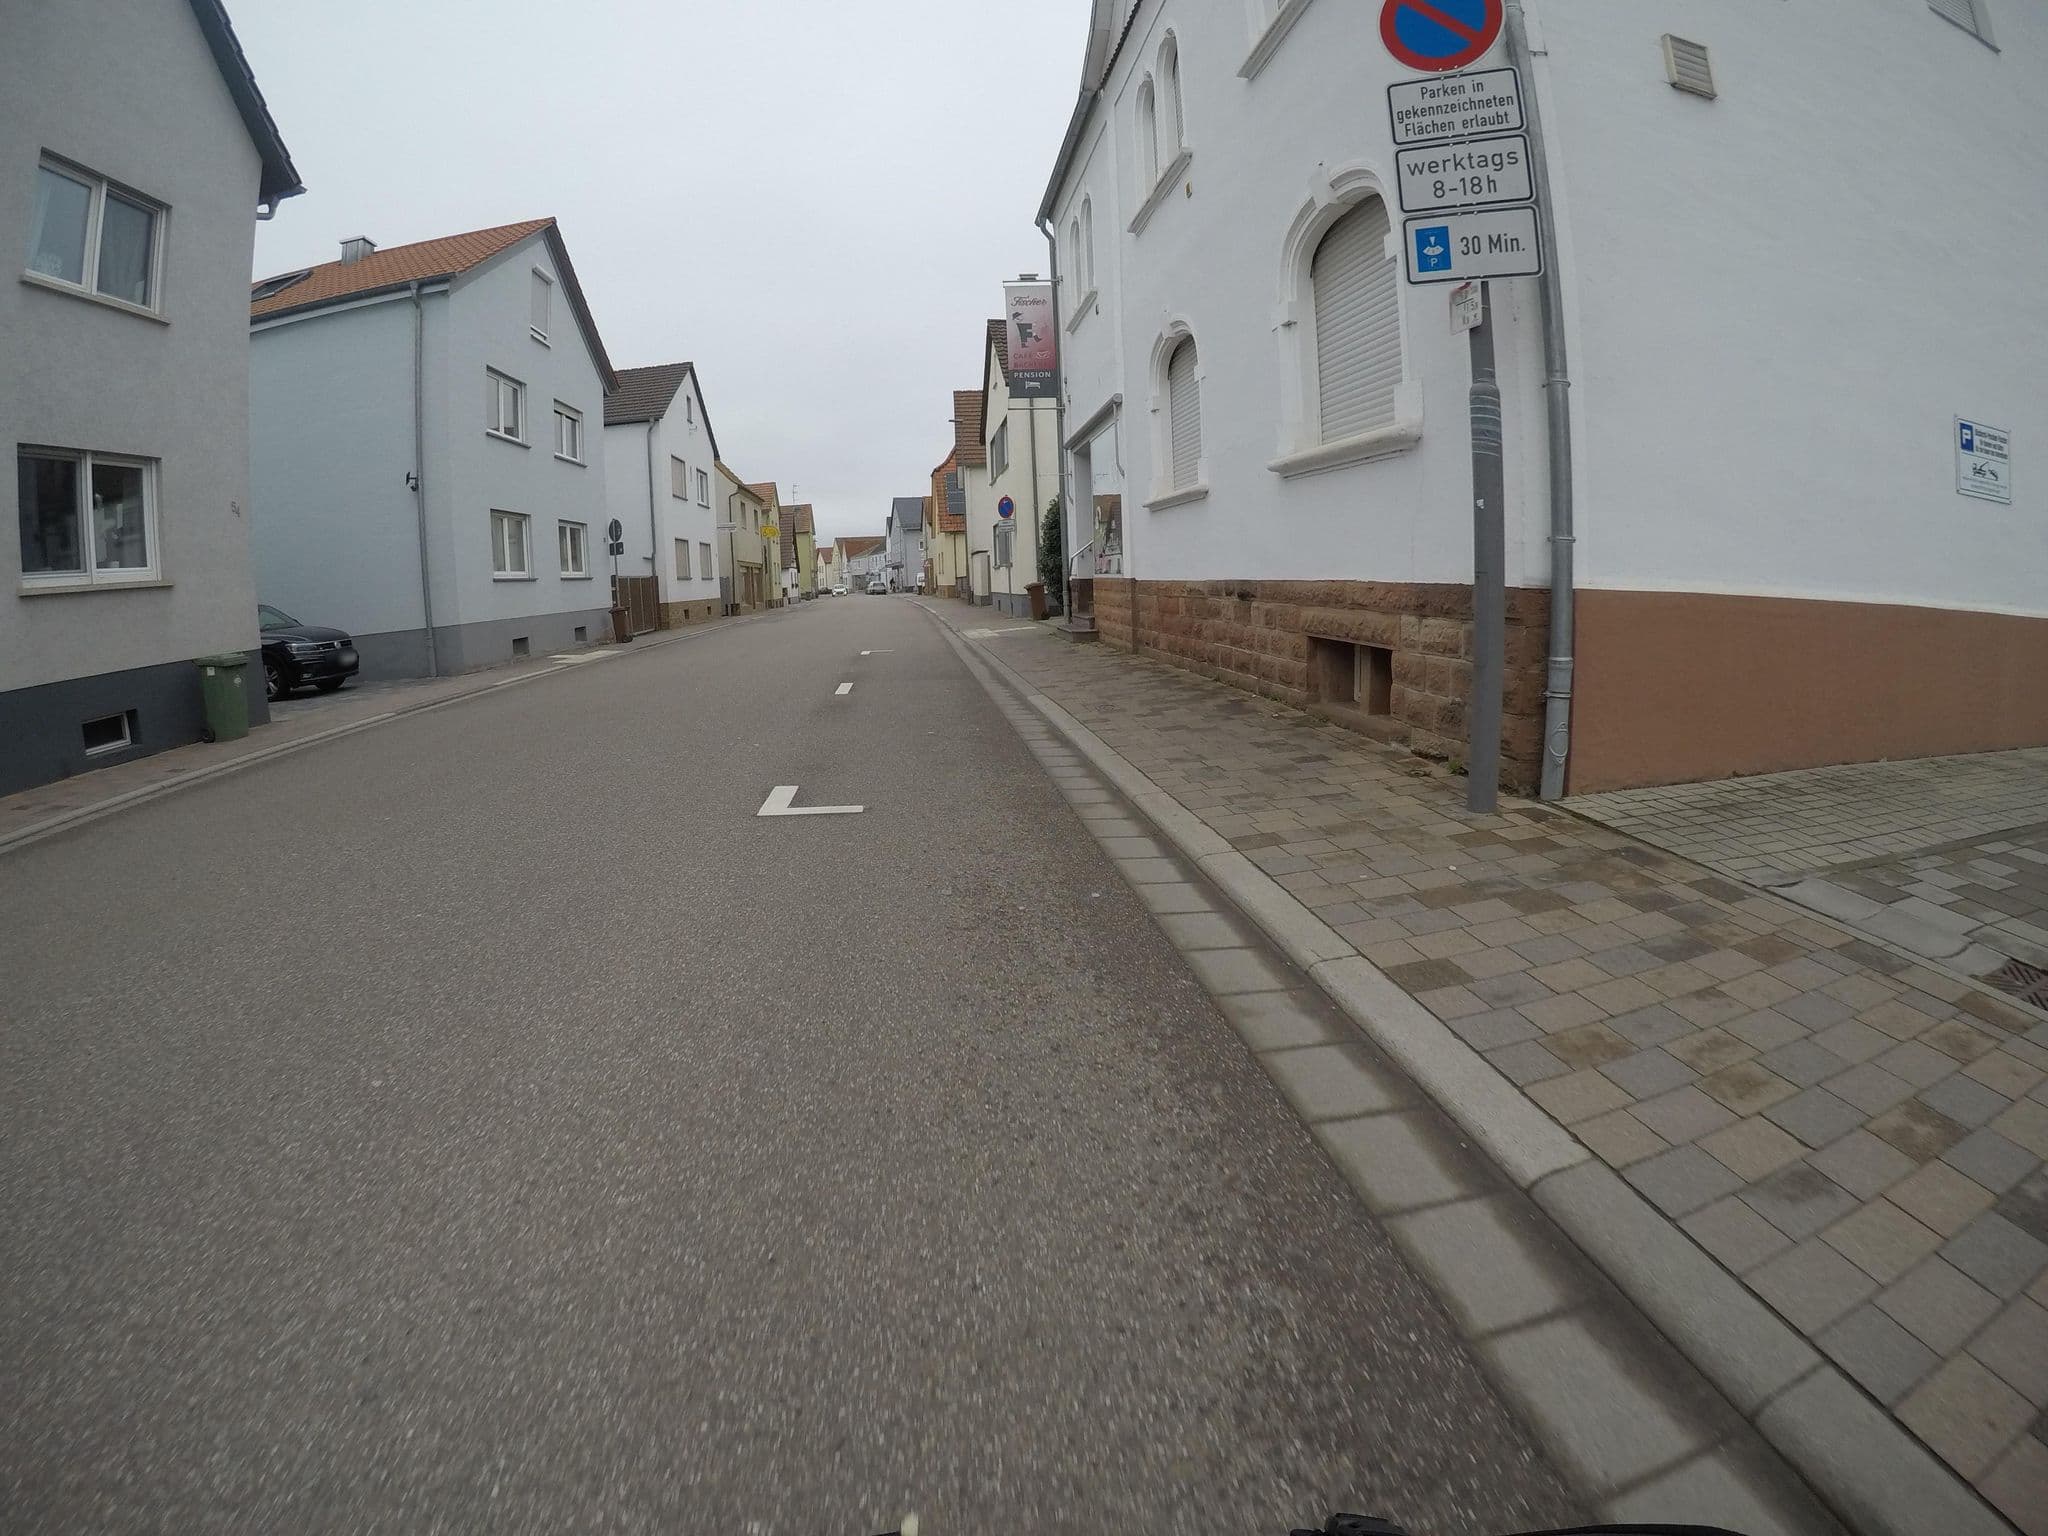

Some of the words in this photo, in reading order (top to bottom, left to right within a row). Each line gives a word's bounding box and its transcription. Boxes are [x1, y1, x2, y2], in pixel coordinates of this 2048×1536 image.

[1420, 84, 1466, 100] Parken
[1471, 79, 1484, 93] in
[1396, 95, 1514, 124] gekennzeichneten
[1404, 120, 1455, 137] Flächen
[1462, 111, 1510, 129] erlaubt
[1406, 151, 1519, 177] werktags
[1460, 235, 1481, 256] 30
[1488, 232, 1526, 254] Min.
[1013, 371, 1051, 379] PENSION
